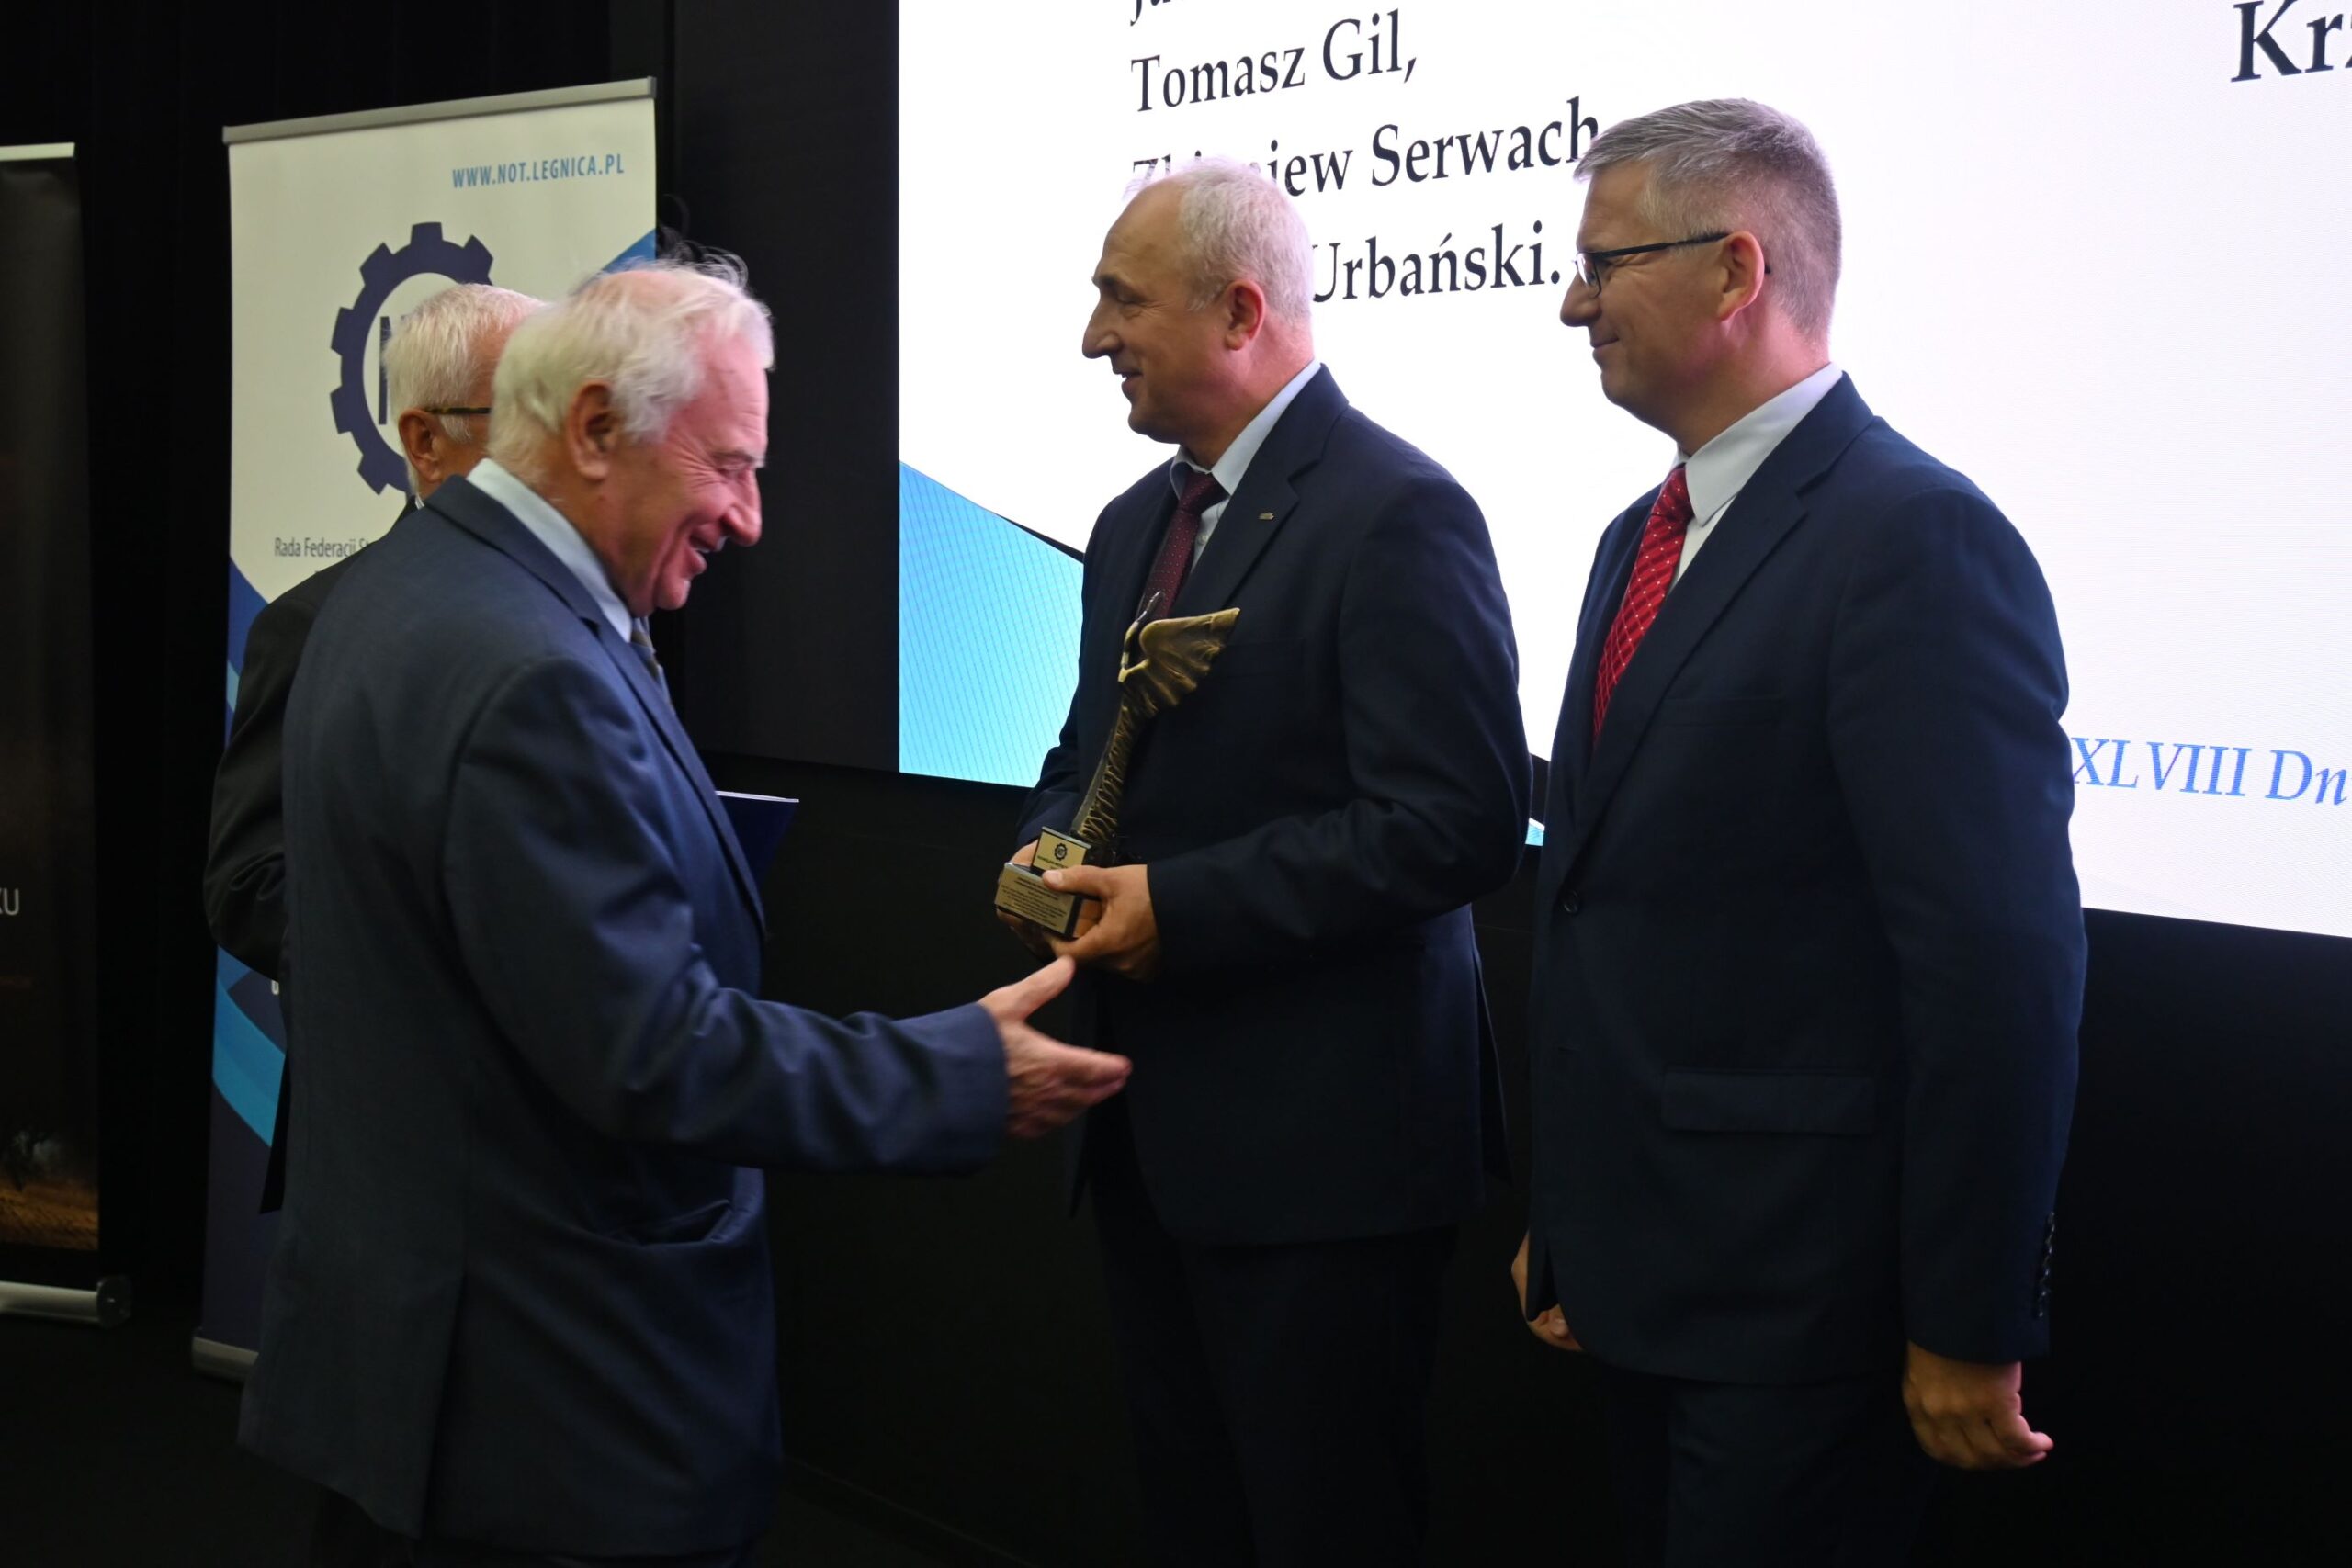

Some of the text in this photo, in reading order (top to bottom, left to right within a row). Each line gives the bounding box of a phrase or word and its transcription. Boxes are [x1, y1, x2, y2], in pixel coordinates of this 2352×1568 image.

[1131, 8, 1417, 112] Tomasz Gil,
[2231, 0, 2352, 83] Kr
[452, 153, 625, 188] WWW.NOT.LEGNICA.PL
[1372, 96, 1600, 186] Serwach
[1313, 220, 1561, 303] Urbański.
[275, 537, 301, 557] Rada
[304, 537, 356, 558] Federacji
[2071, 737, 2253, 797] XLVIII
